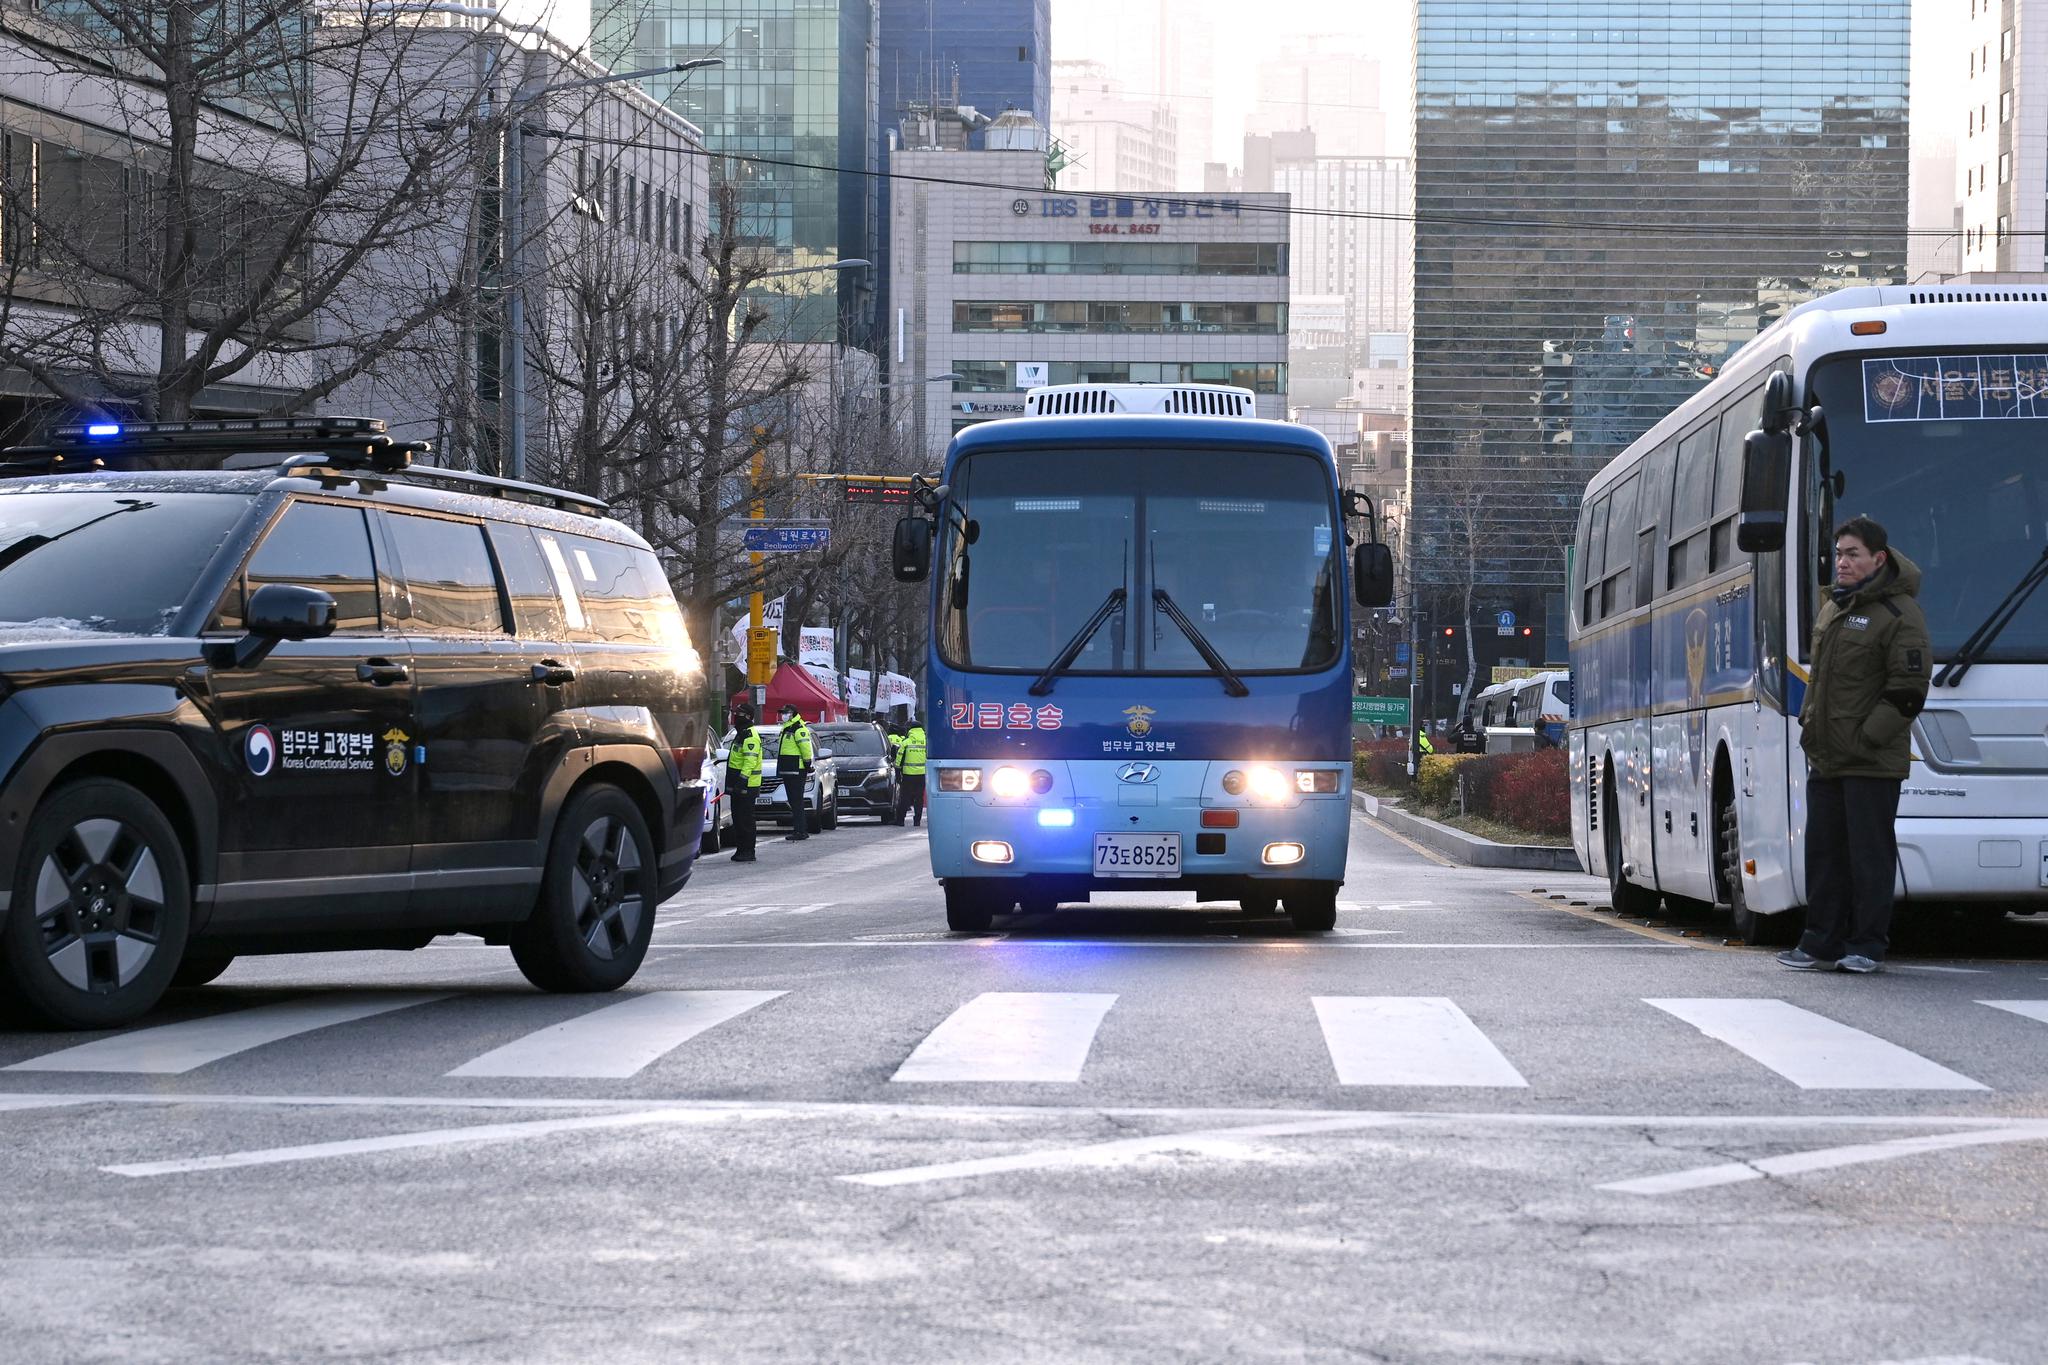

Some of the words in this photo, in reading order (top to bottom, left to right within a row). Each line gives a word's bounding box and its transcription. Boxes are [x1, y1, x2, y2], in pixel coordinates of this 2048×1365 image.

[1041, 199, 1078, 217] IBS
[779, 530, 827, 541] 법원로4길
[1848, 615, 1868, 624] TEAM
[1387, 702, 1405, 711] 등기국
[951, 702, 1063, 730] 긴급호송
[281, 730, 320, 755] 법무부
[323, 732, 374, 755] 교정본부
[1102, 741, 1132, 752] 법무부
[1134, 741, 1176, 752] 교정본부
[282, 757, 304, 769] Korea
[304, 757, 348, 770] Correctional
[348, 757, 374, 770] Service
[1097, 845, 1177, 866] 73도8525
